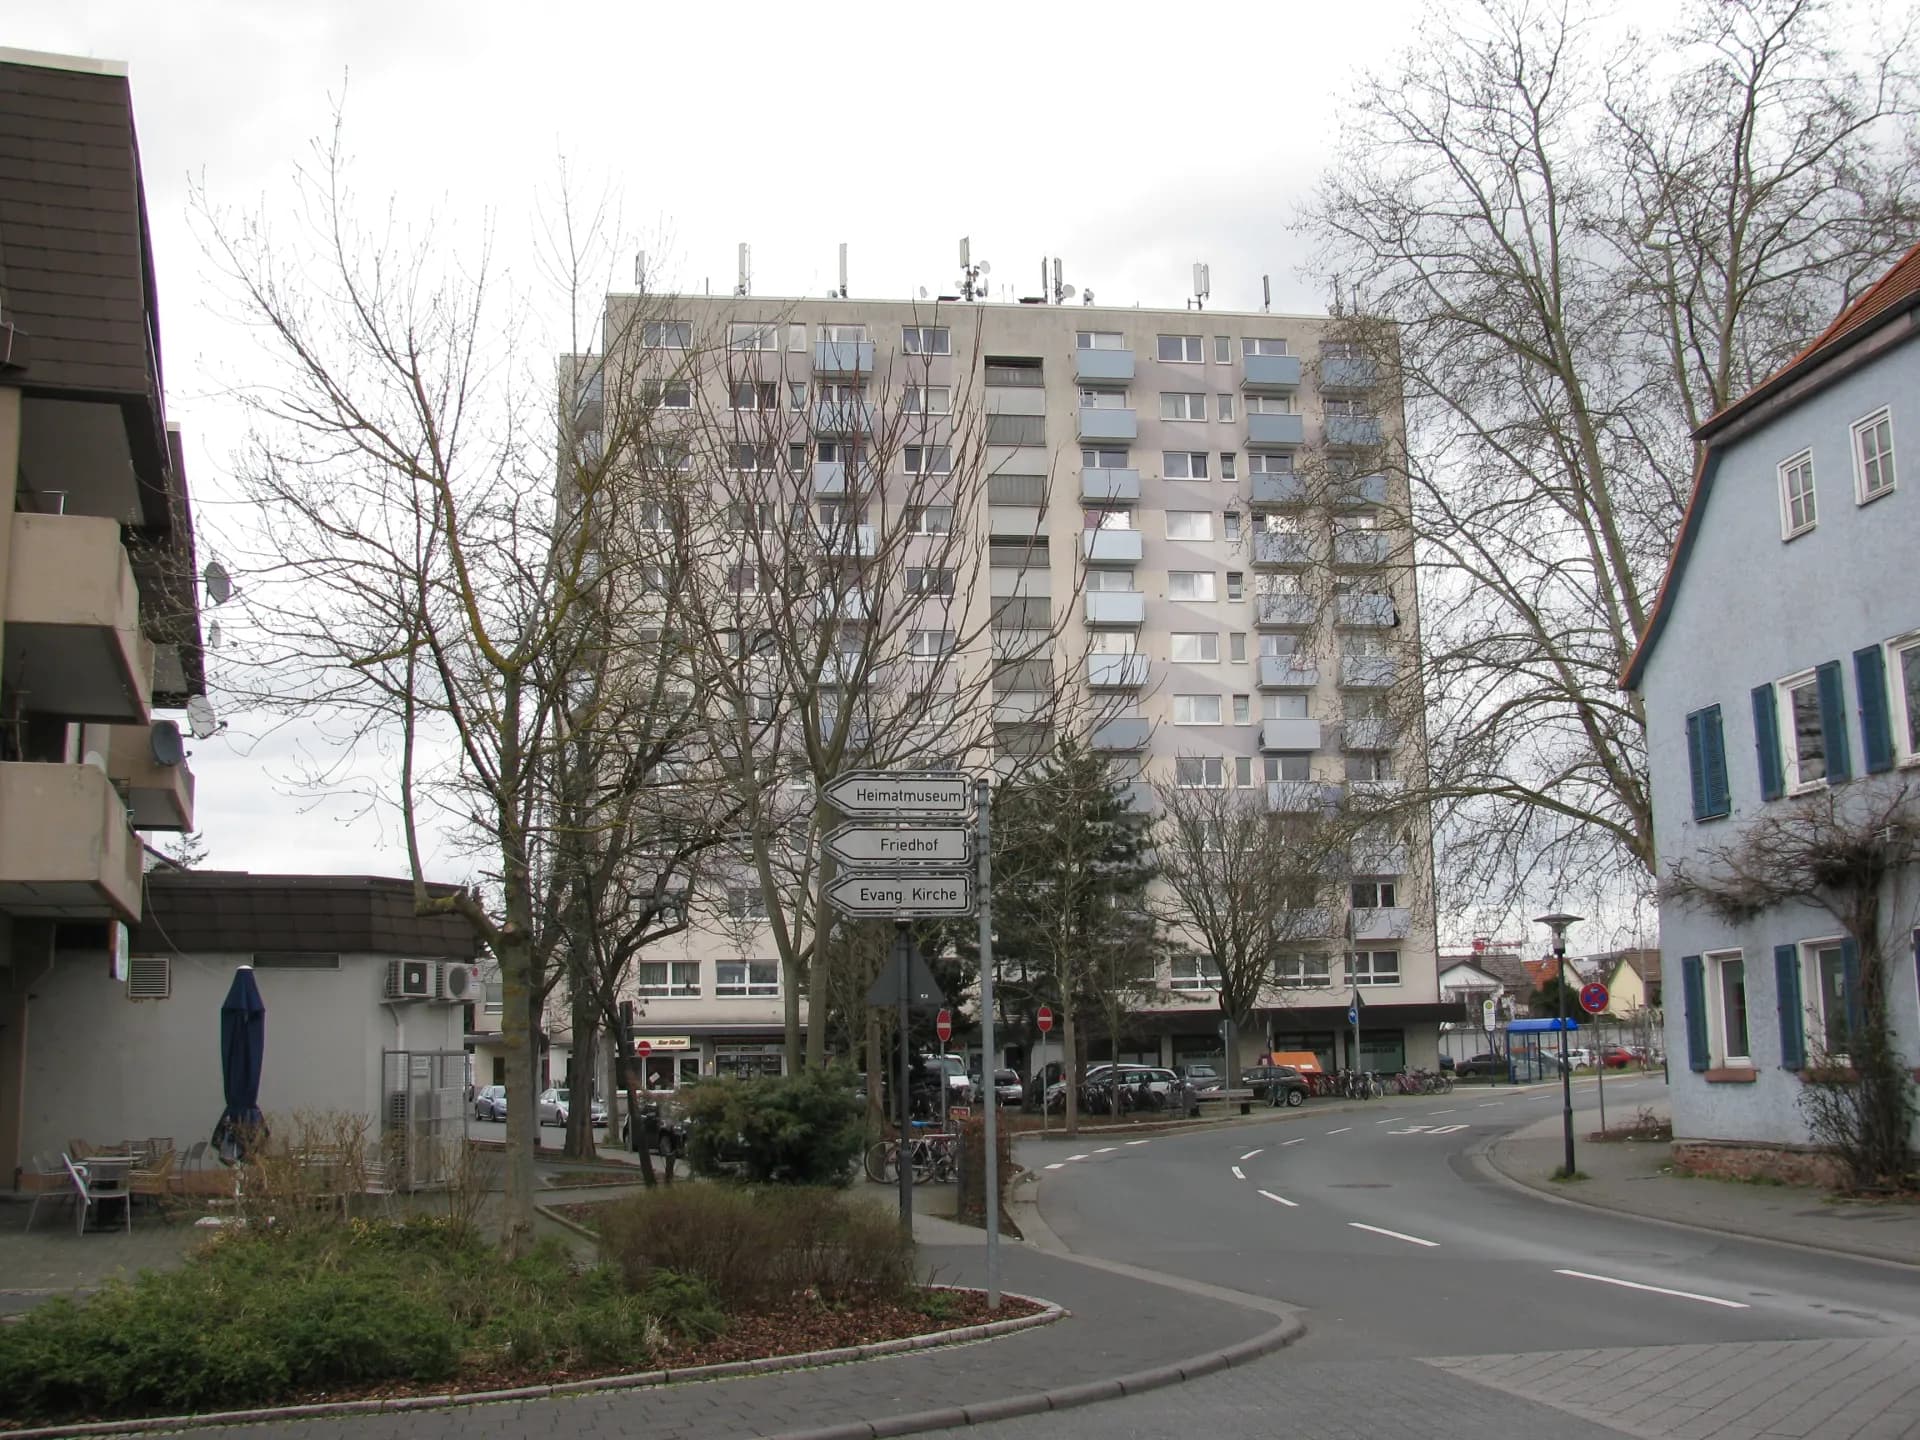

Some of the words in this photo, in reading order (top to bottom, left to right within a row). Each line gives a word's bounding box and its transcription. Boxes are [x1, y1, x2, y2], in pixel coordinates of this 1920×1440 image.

[857, 788, 961, 802] Heimatmuseum
[880, 838, 939, 851] Friedhof
[912, 887, 957, 900] Kirche
